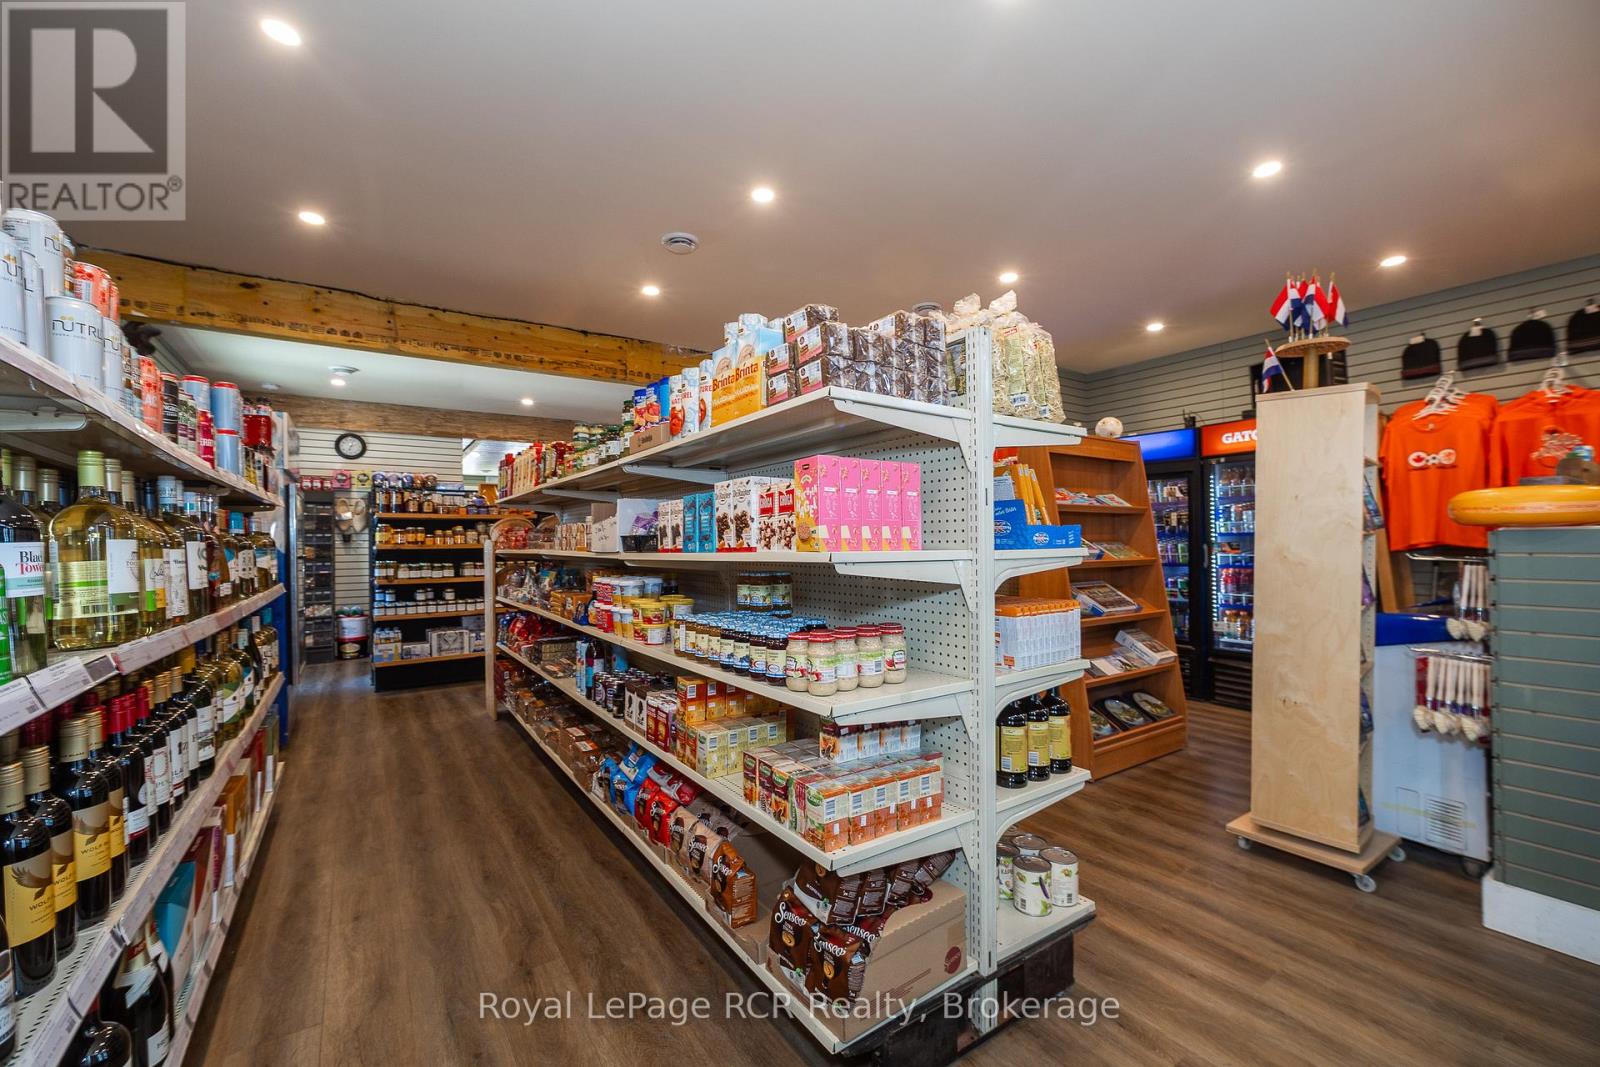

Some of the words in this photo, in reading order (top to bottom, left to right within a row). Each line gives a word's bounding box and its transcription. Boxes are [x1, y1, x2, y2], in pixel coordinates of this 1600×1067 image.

[735, 360, 759, 382] Brinta
[712, 374, 735, 392] Brinta
[842, 924, 879, 943] enseo
